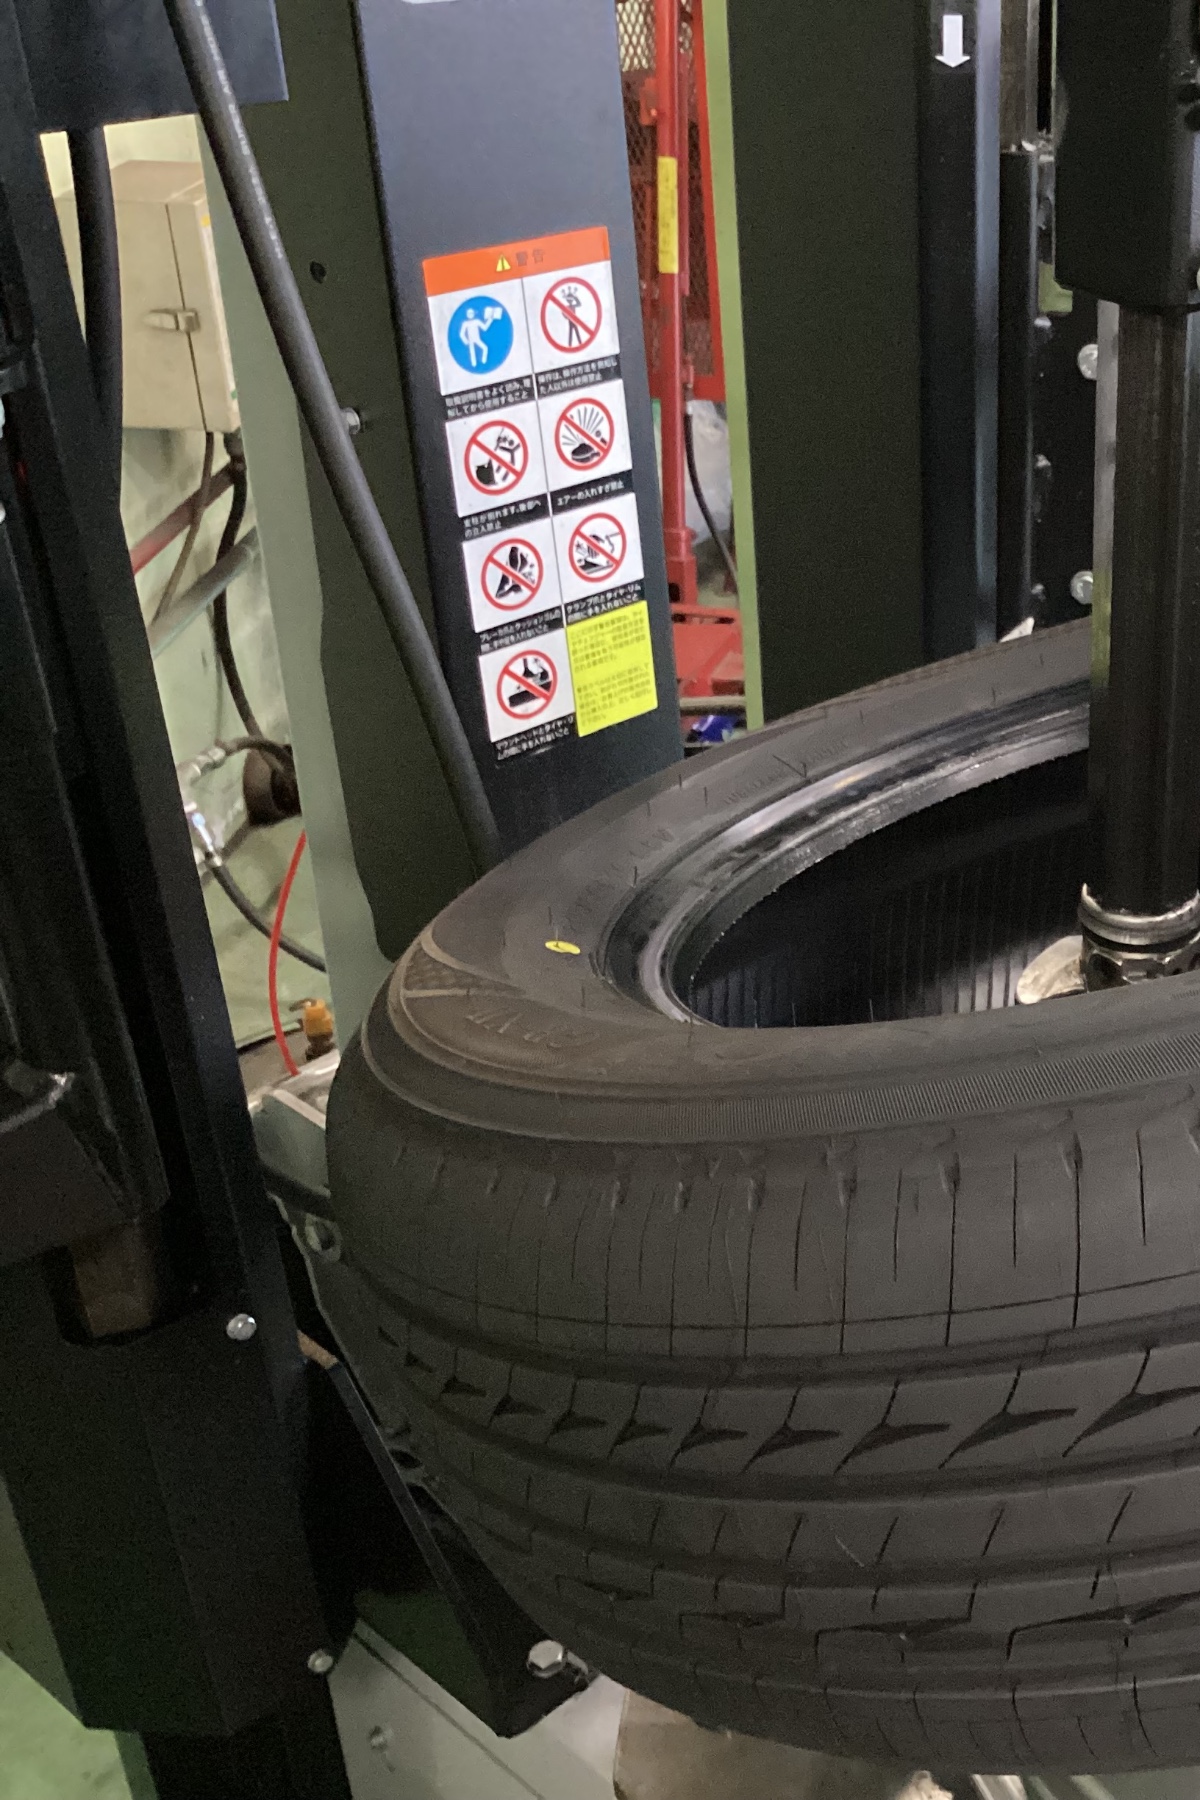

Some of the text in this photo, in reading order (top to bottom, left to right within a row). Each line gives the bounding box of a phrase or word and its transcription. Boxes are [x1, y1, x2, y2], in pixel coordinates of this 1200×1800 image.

[556, 477, 624, 507] エアーの入れすぎ禁止
